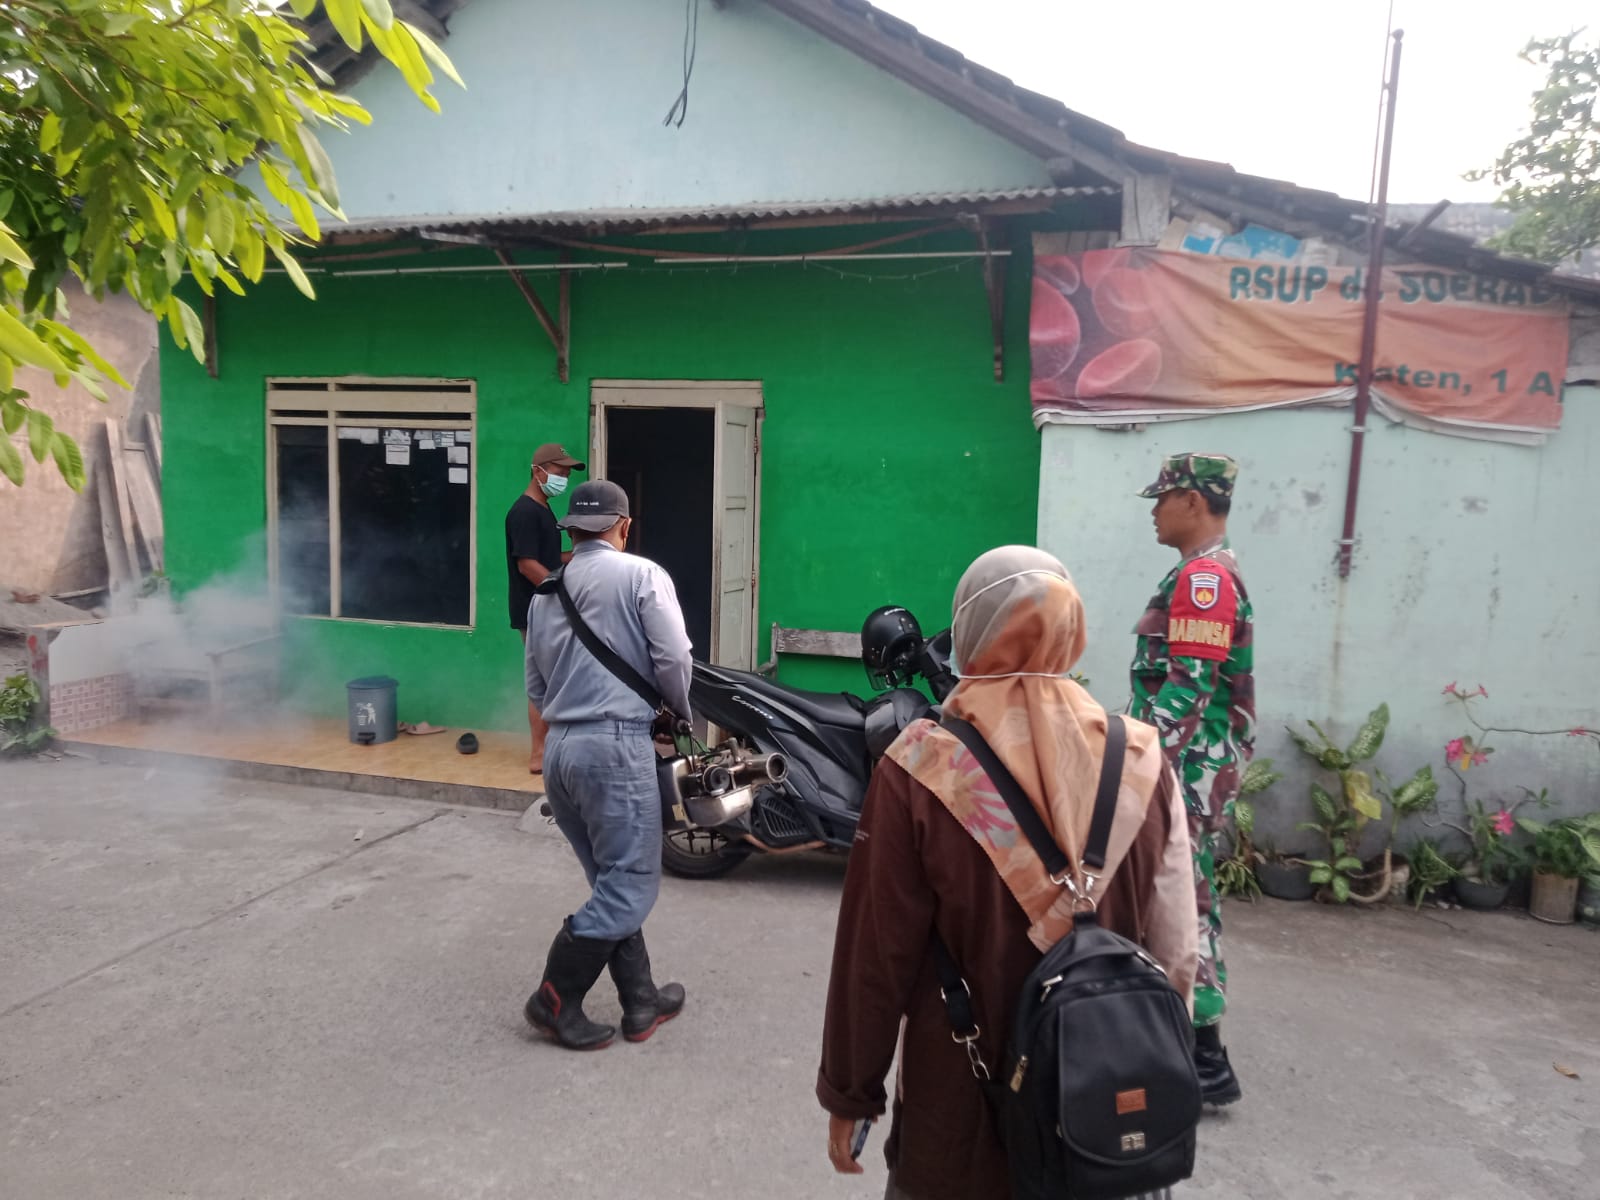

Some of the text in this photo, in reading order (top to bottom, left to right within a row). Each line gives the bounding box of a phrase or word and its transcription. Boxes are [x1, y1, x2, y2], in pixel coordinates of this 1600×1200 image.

[1229, 265, 1328, 303] RSUP
[1334, 362, 1472, 396] Katen,
[1491, 368, 1508, 393] 1
